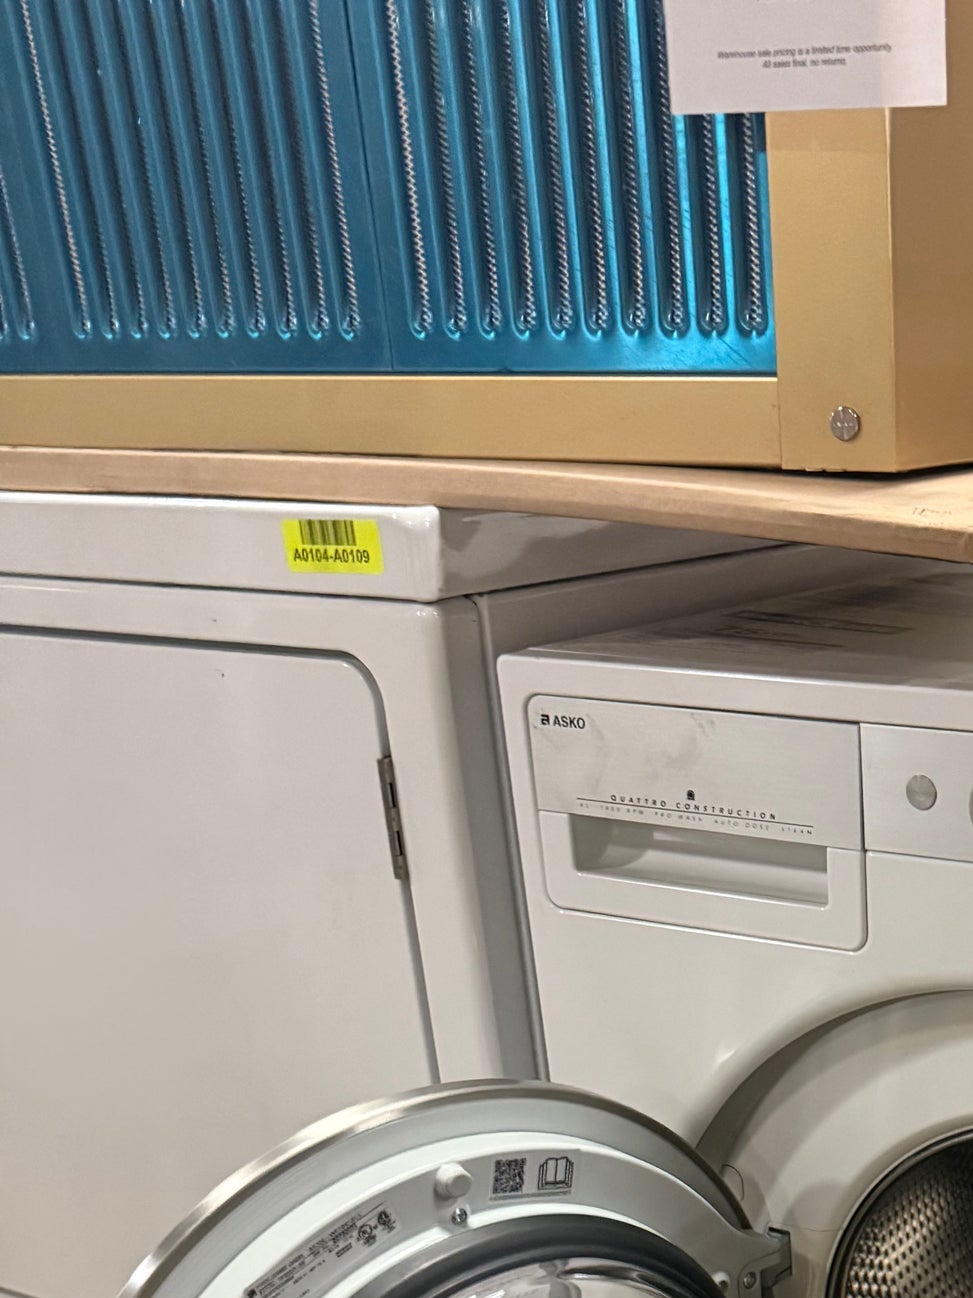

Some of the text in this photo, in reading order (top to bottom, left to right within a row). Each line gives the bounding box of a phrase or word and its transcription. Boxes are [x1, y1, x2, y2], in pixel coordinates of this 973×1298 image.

[294, 548, 370, 564] A0104-A0109
[553, 714, 586, 730] ASKO
[610, 794, 776, 820] QUATTRO CONSTRUCTION
